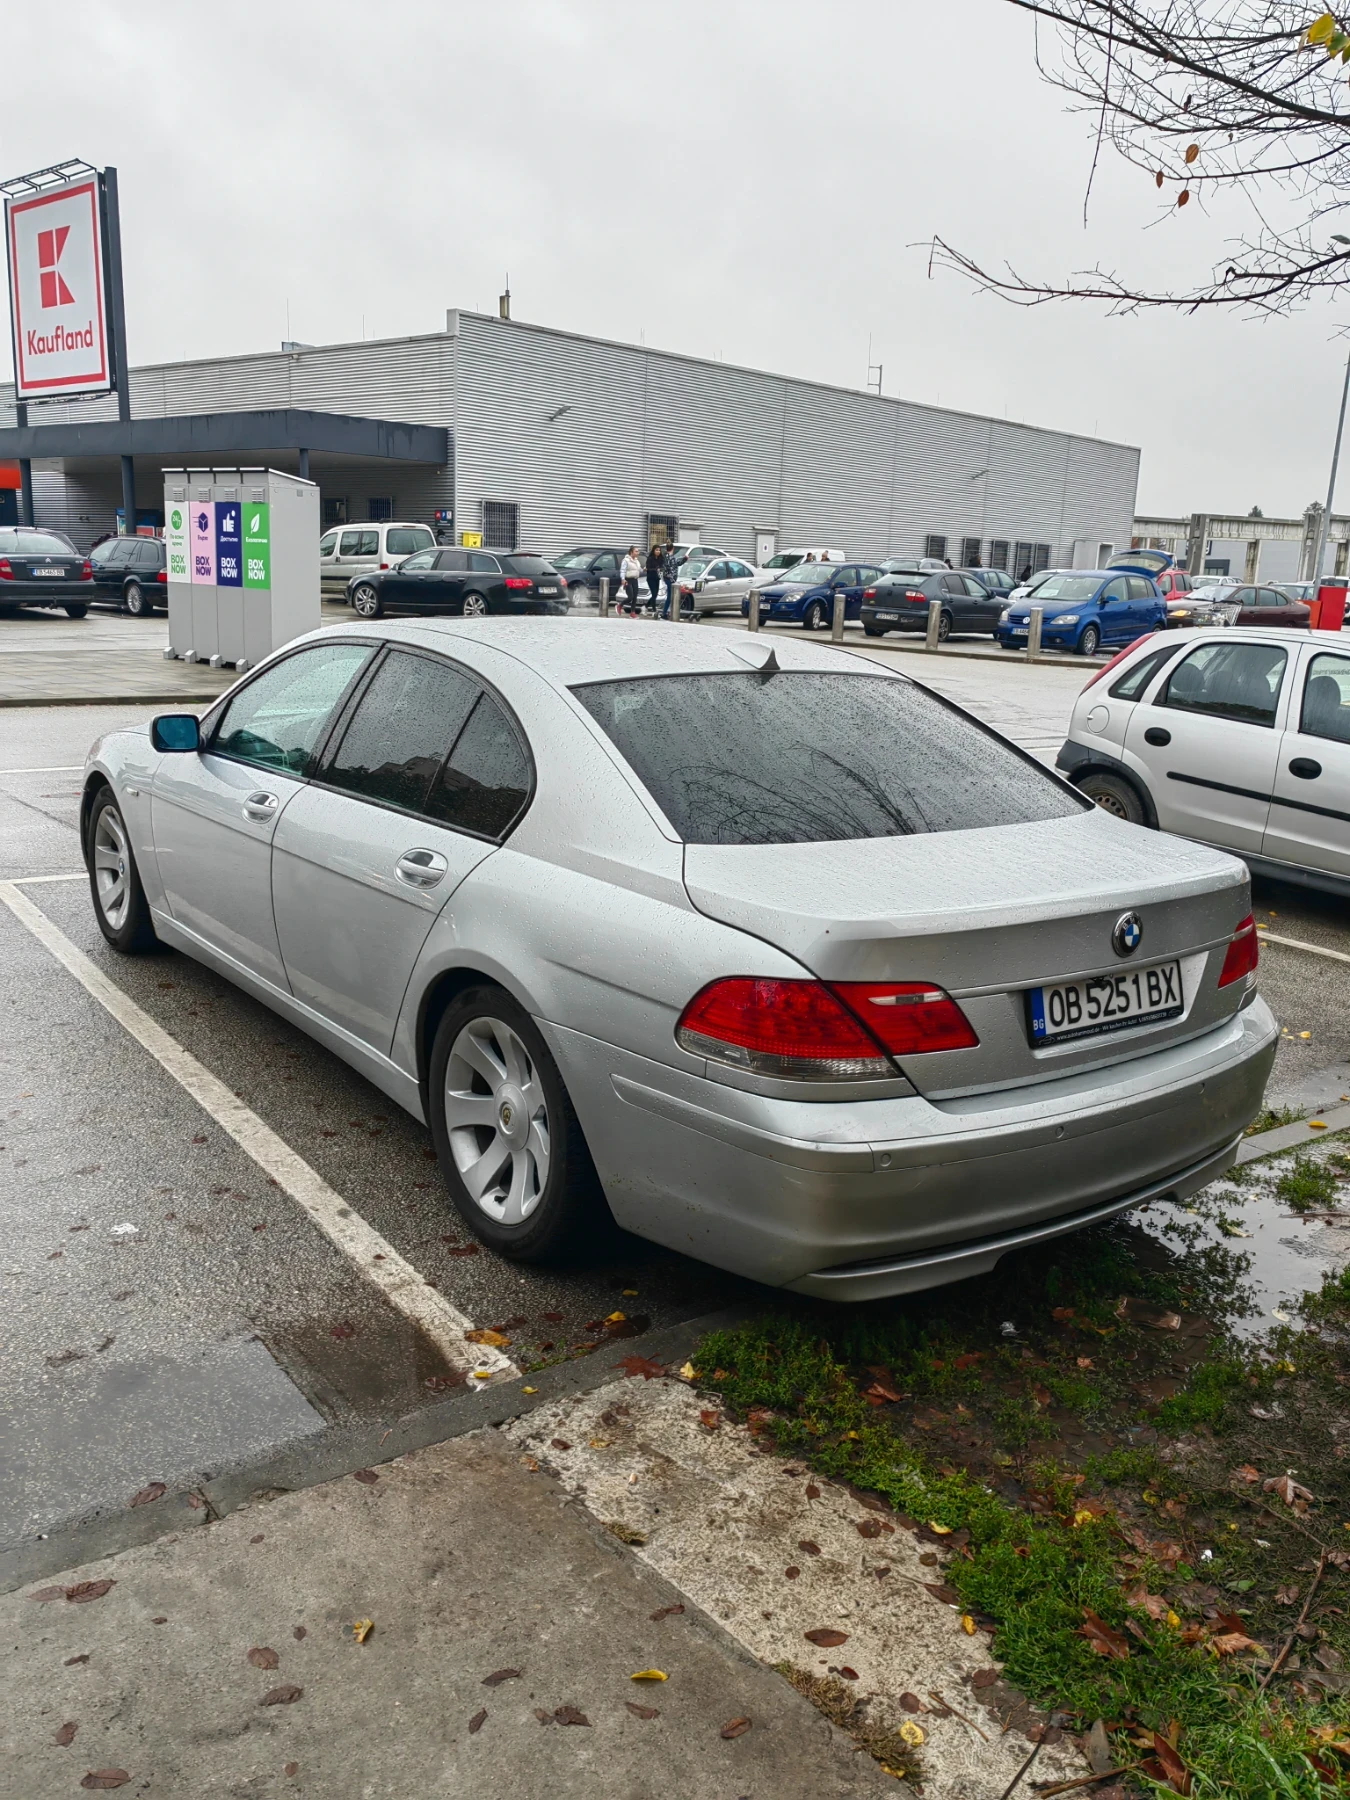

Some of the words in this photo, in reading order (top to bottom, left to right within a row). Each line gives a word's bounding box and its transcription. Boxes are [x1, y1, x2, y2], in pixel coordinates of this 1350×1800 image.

[27, 320, 93, 356] Kaufland
[170, 554, 185, 564] BOX
[195, 556, 210, 566] BOX
[221, 557, 236, 568] BOX
[170, 565, 186, 574] NOW
[248, 559, 263, 570] BOX
[196, 567, 211, 576] NOW
[221, 567, 238, 578] NOW
[248, 570, 265, 580] NOW
[1033, 1019, 1044, 1031] BG
